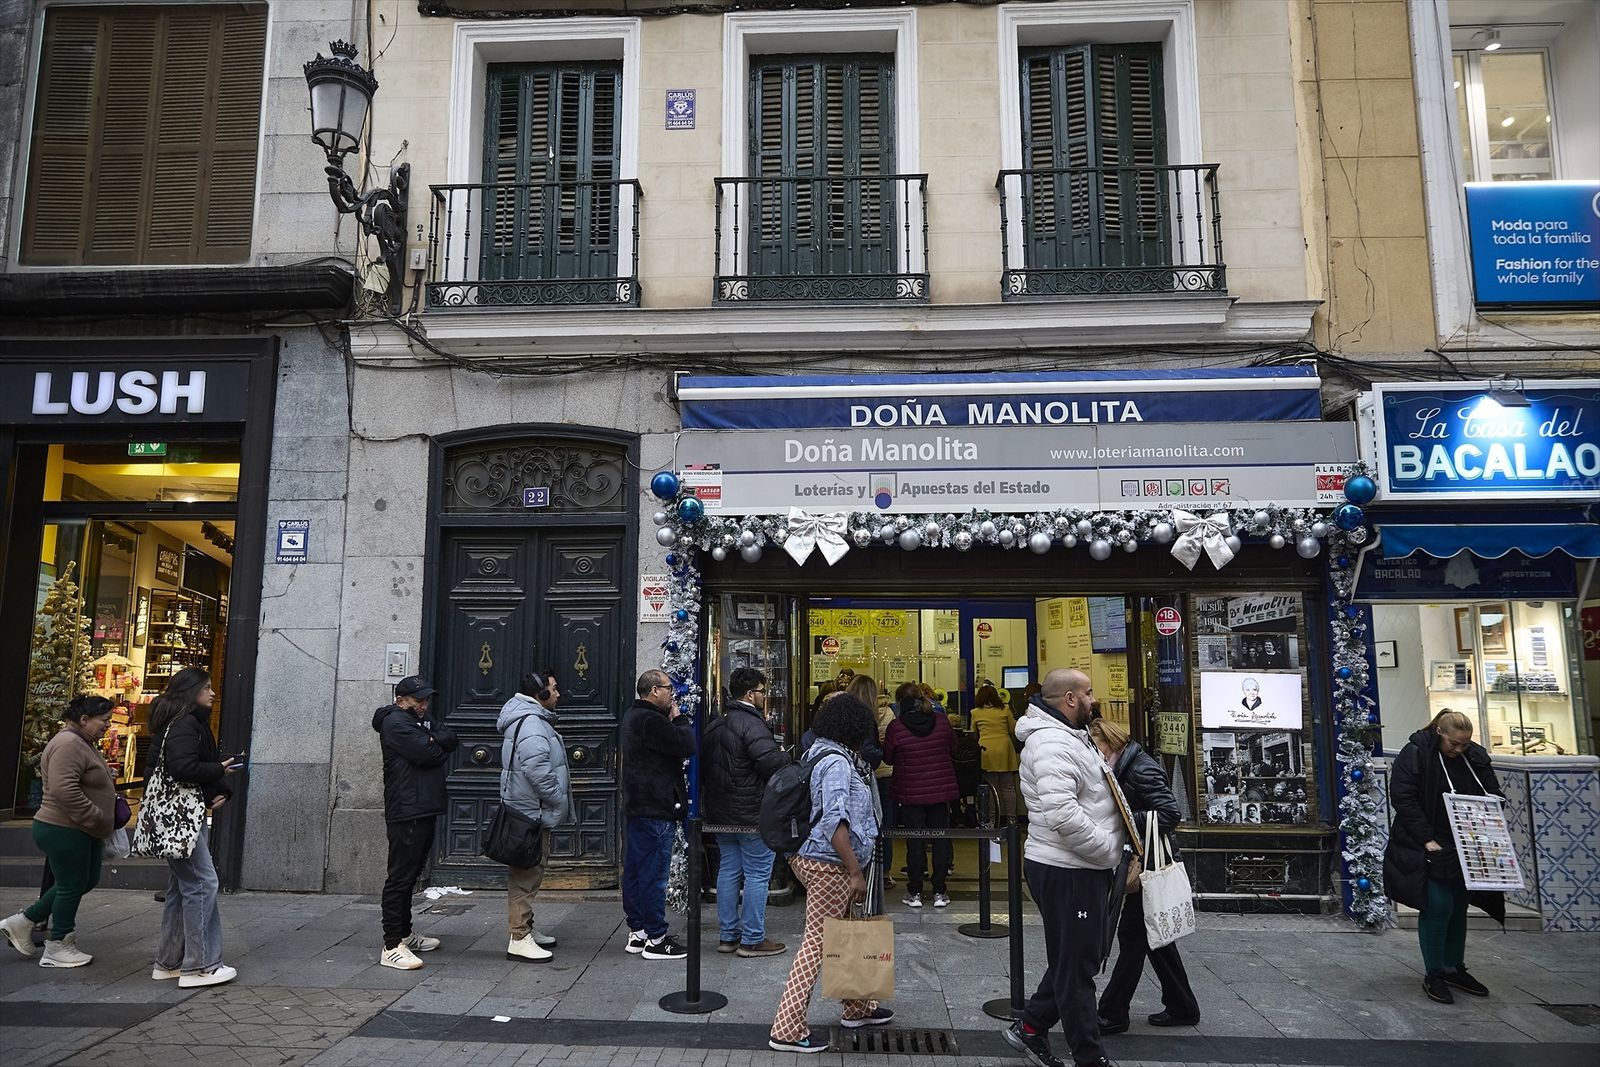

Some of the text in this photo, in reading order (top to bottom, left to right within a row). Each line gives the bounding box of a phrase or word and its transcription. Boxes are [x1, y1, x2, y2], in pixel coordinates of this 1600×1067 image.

[1491, 219, 1568, 232] Moda para
[1493, 232, 1591, 245] toda la familia
[1496, 258, 1599, 270] Fashion for the
[1497, 271, 1584, 286] whole family
[31, 370, 207, 415] LUSH
[850, 398, 1144, 427] DOÑA MANOLITA
[1408, 407, 1584, 439] La Casa del
[784, 436, 978, 463] Doña Manolita
[1050, 444, 1246, 460] www.loteriamanolita.com
[1393, 442, 1600, 481] BACALAO
[794, 479, 1051, 499] Loterías y Apuestas del Estado
[528, 491, 544, 503] 22
[1374, 569, 1421, 579] BACALAO
[839, 618, 863, 626] 48020
[876, 618, 901, 626] 74778
[1160, 610, 1175, 620] +18
